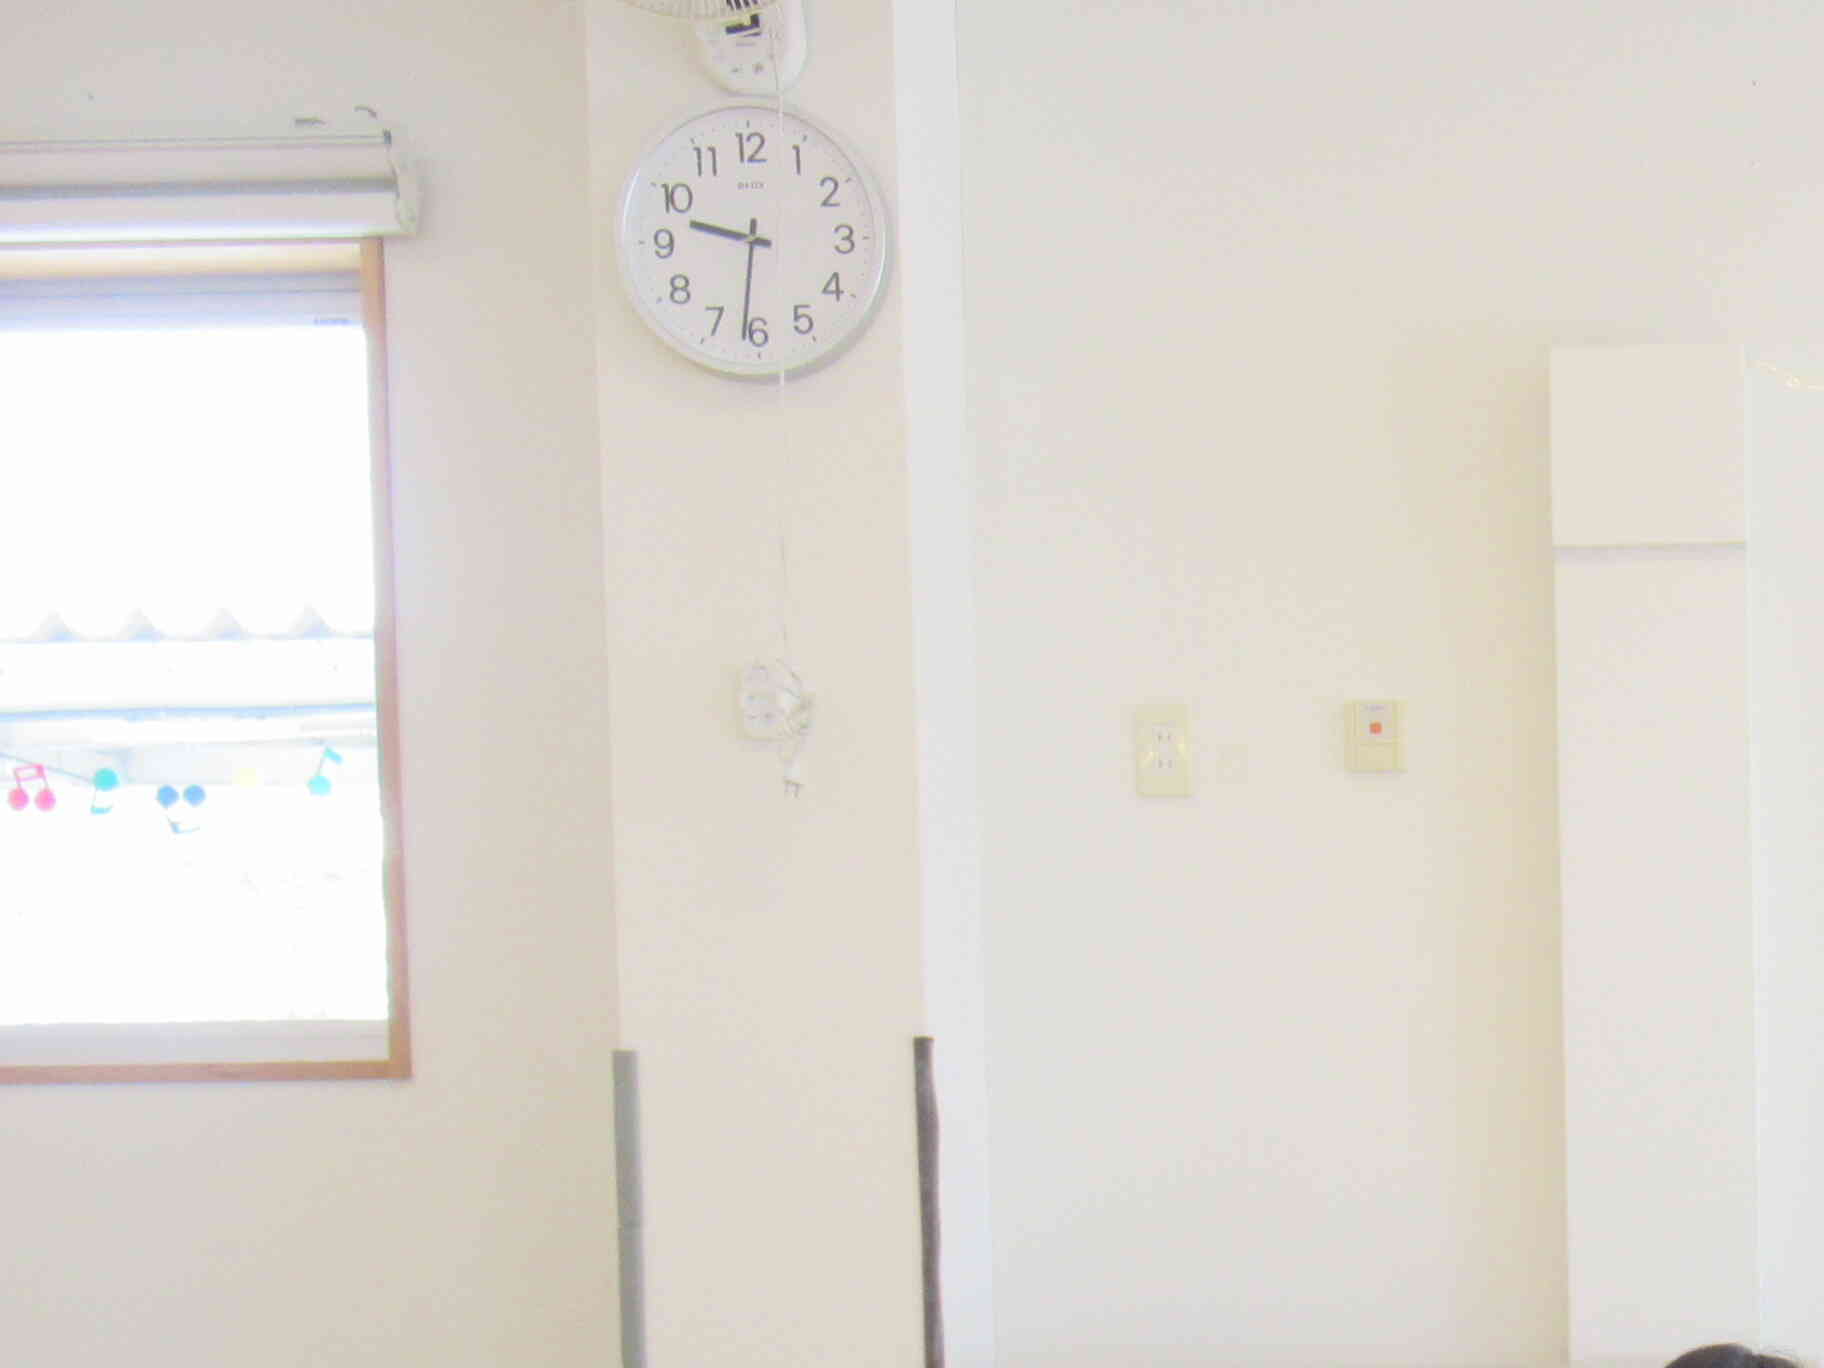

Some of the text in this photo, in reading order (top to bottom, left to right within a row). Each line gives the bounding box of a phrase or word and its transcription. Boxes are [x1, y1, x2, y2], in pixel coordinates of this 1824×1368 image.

[693, 146, 718, 177] 11
[735, 132, 767, 163] 12
[792, 144, 801, 175] 1
[661, 183, 693, 213] 10
[819, 176, 841, 208] 2
[653, 229, 675, 259] 9
[833, 224, 855, 254] 3
[669, 274, 691, 304] 8
[821, 271, 844, 302] 4
[705, 306, 725, 336] 7
[749, 317, 769, 347] 6
[793, 304, 814, 335] 5
